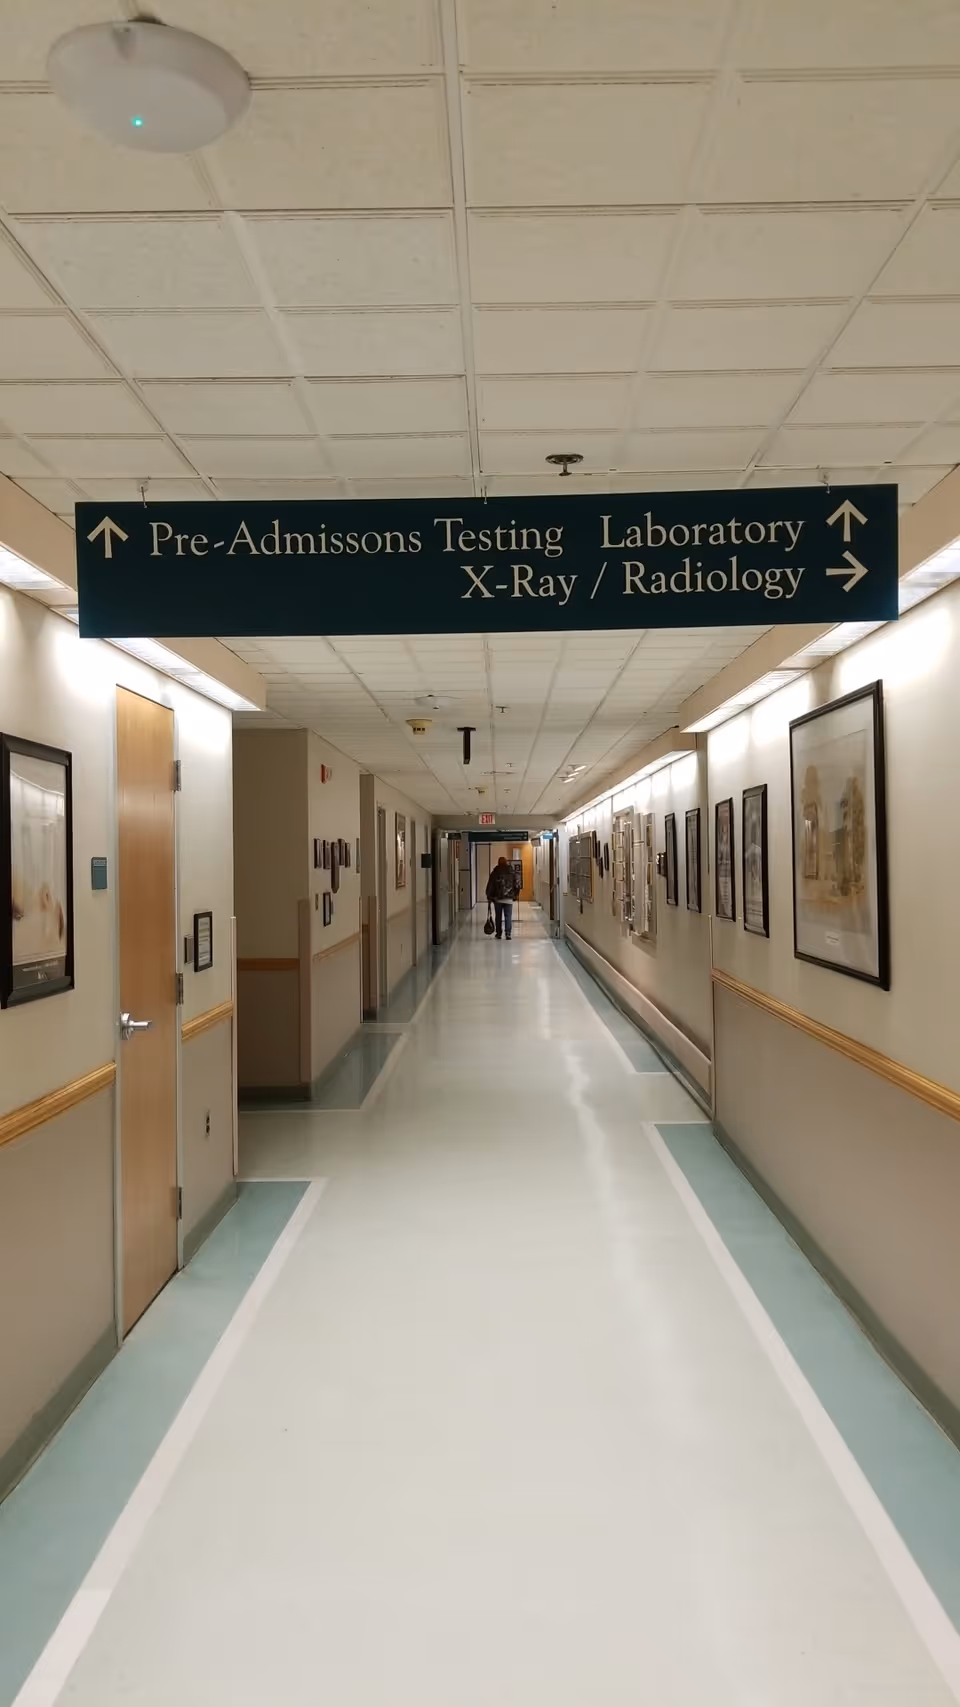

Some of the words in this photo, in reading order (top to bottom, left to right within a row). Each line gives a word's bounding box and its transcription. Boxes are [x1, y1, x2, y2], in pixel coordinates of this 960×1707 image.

[149, 519, 422, 556] Pre-Admissons
[433, 517, 564, 558] Testing
[599, 511, 805, 552] Laboratory
[460, 564, 578, 606] X-Ray
[590, 561, 608, 600] /
[621, 555, 806, 600] Radiology
